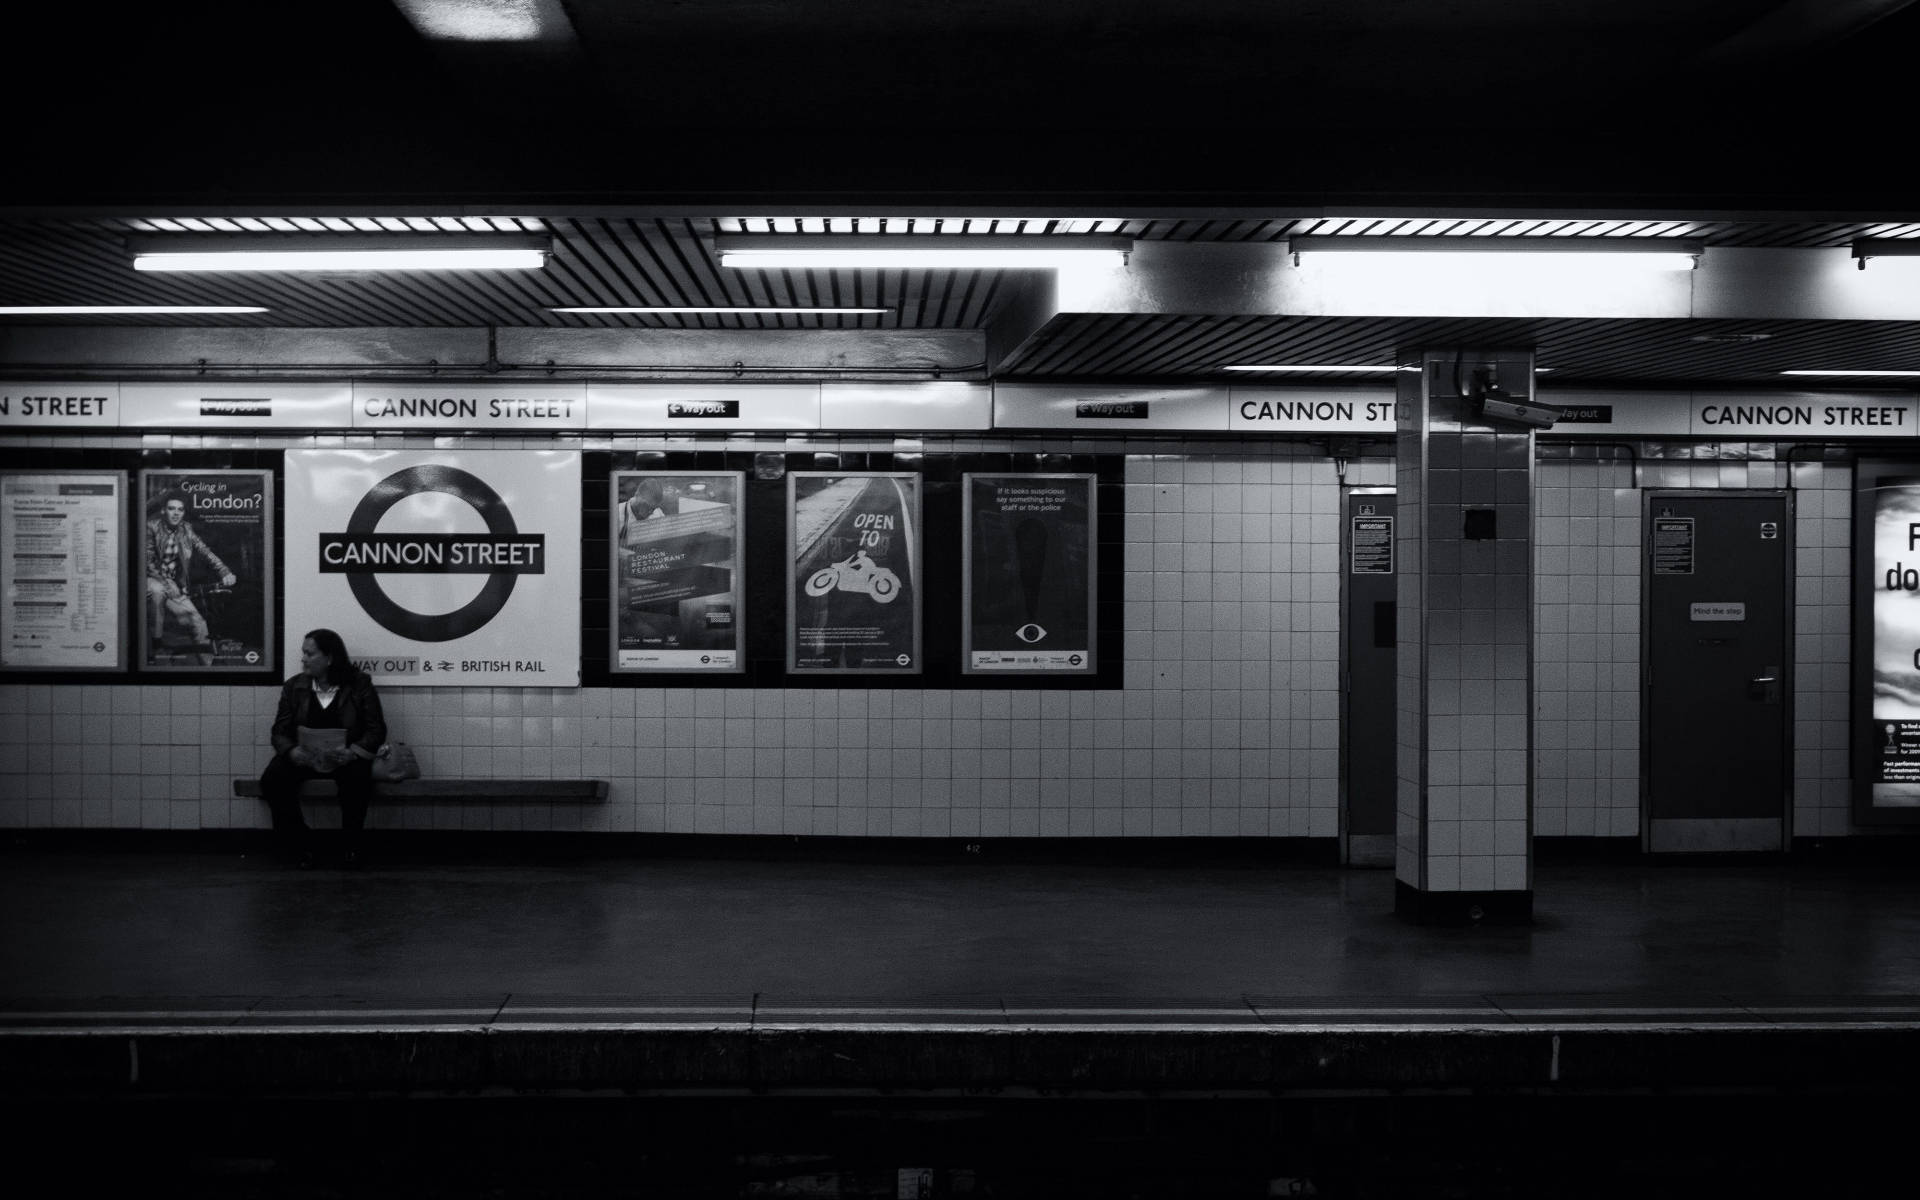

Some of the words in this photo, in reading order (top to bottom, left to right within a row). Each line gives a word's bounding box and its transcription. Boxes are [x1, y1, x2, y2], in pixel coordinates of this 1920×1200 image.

[22, 396, 108, 416] STREET
[364, 398, 477, 419] CANNON
[489, 398, 575, 419] STREET
[1240, 401, 1353, 421] CANNON
[1366, 402, 1397, 421] ST
[1579, 408, 1600, 418] out
[1701, 406, 1812, 426] CANNON
[1823, 406, 1908, 426] STREET
[181, 481, 216, 494] Cycling
[218, 482, 227, 491] in
[1011, 487, 1029, 495] looks
[1030, 487, 1065, 496] suspicious
[193, 493, 262, 509] London?
[1009, 496, 1044, 504] something
[1040, 504, 1061, 512] police
[854, 513, 894, 530] OPEN
[858, 530, 880, 547] TO
[324, 542, 443, 564] CANNON
[450, 542, 541, 565] STREET
[632, 551, 666, 562] LONDON
[632, 553, 686, 568] RESTAURANT
[632, 563, 671, 574] FESTIVAL
[1694, 607, 1711, 615] Mind
[1712, 607, 1724, 615] the
[1726, 608, 1742, 616] step
[384, 660, 417, 673] OUT
[423, 660, 434, 672] &
[462, 660, 511, 673] BRITISH
[515, 660, 546, 673] RAIL
